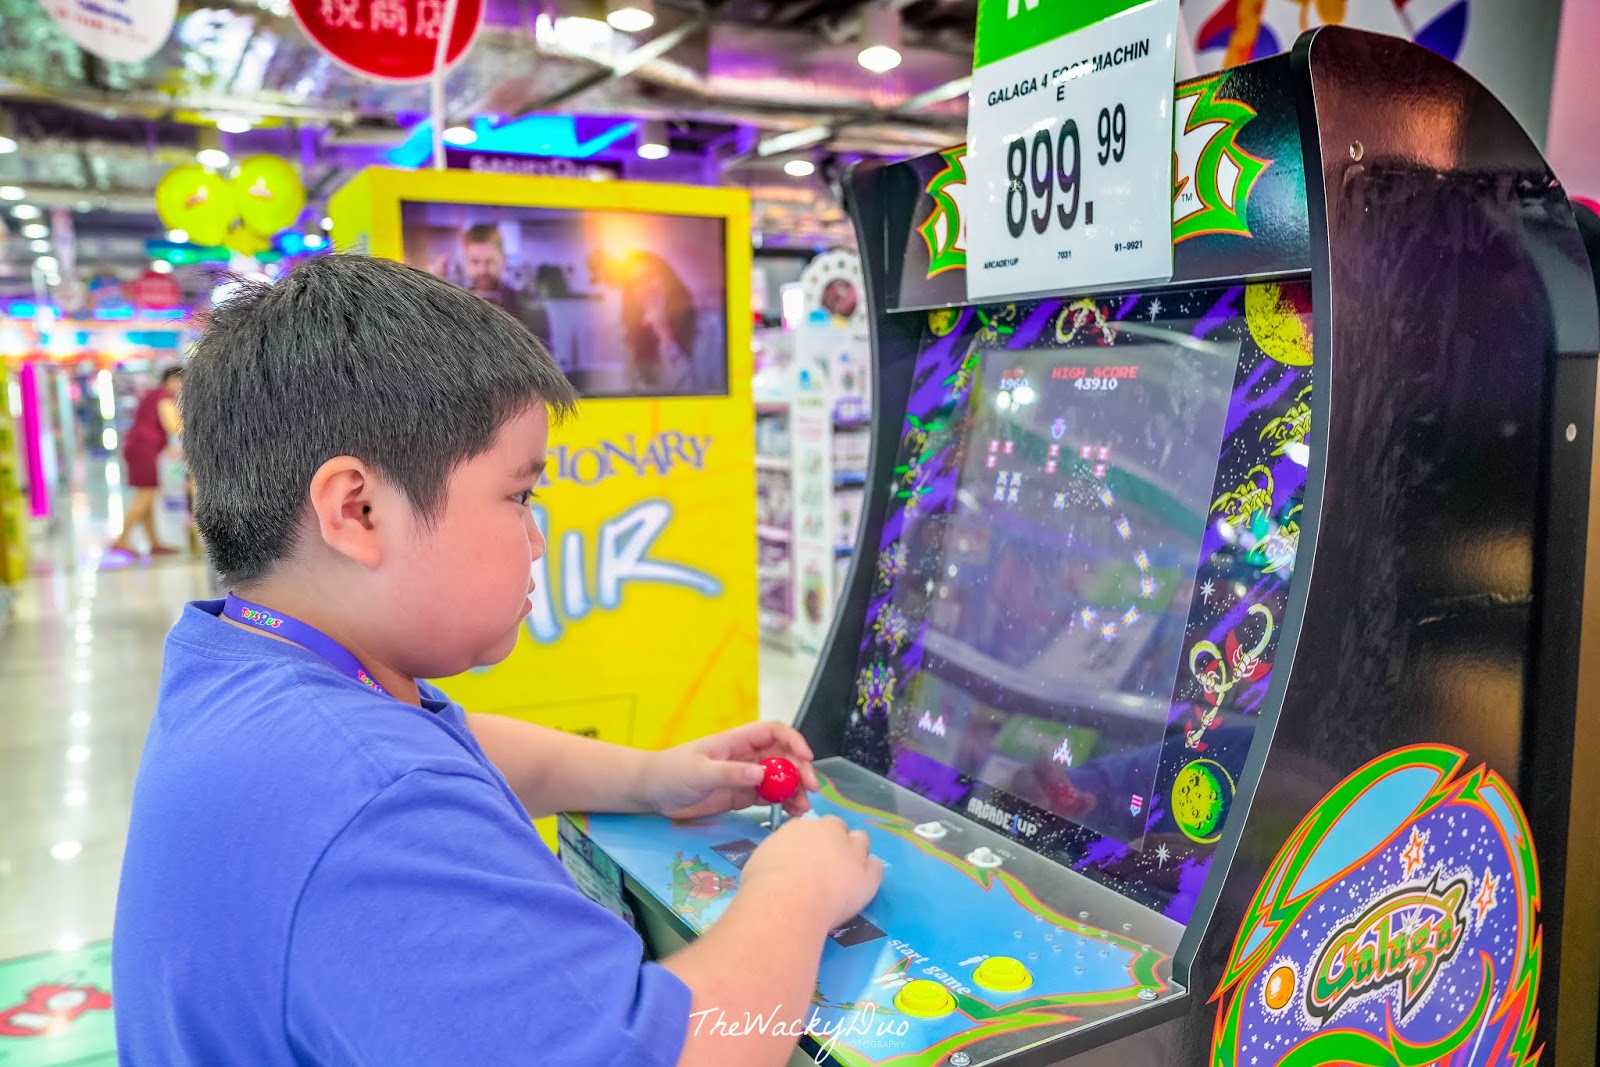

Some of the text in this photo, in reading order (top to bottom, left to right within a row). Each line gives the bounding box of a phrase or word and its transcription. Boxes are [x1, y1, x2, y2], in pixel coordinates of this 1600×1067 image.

[987, 78, 1038, 106] GALAGA
[1041, 73, 1048, 89] 4
[1092, 38, 1150, 73] MACHIN
[1056, 85, 1065, 101] E
[1097, 103, 1127, 166] 99
[1114, 239, 1144, 253] 91-9921
[1057, 250, 1072, 260] 7031
[1051, 365, 1138, 379] HIGH SCORE
[1073, 377, 1119, 391] 43910
[1312, 885, 1462, 1006] Galaga
[888, 940, 972, 995] start game
